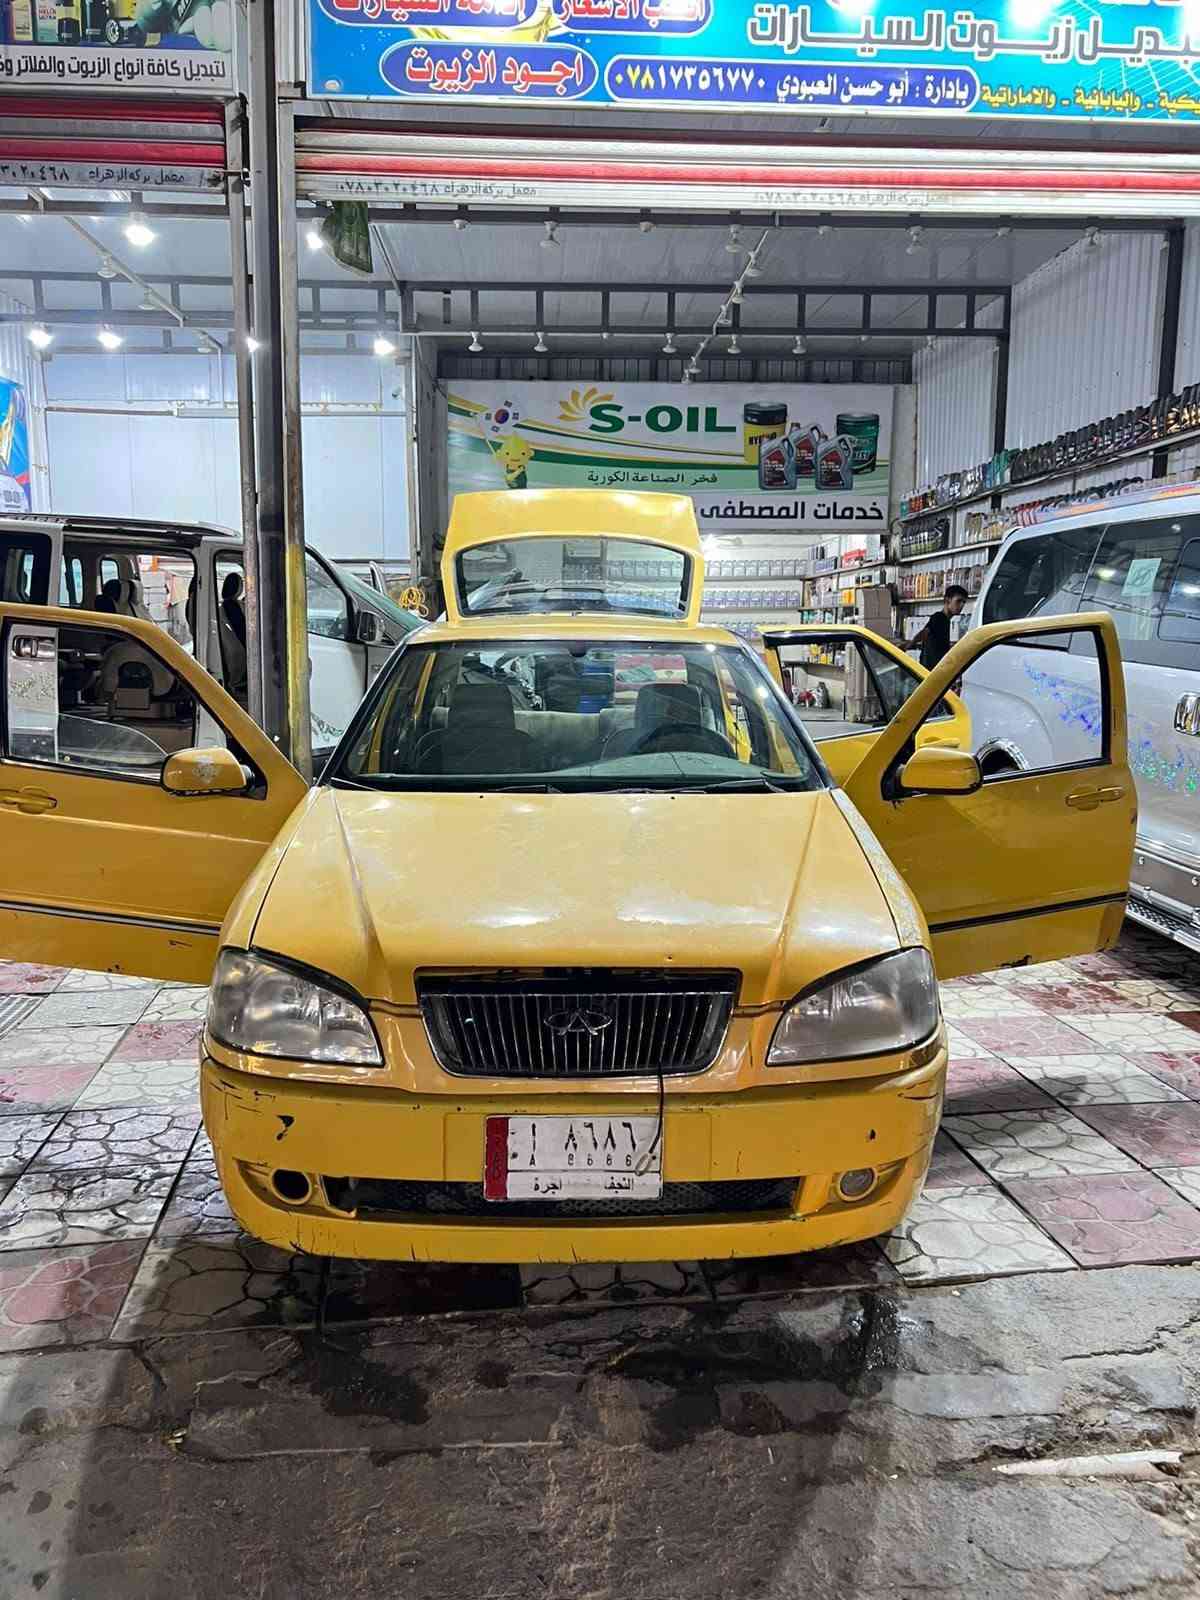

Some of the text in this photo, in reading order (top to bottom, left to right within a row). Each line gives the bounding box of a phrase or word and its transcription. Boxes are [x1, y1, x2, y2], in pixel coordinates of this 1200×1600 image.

[750, 6, 1200, 65] بديل زيوت السيارات
[16, 55, 65, 78] والفلاتر
[67, 57, 111, 78] الزيوت
[114, 58, 144, 81] انواع
[147, 58, 181, 77] كافة
[184, 60, 226, 82] لتبديل
[406, 47, 584, 95] اجود الزيوت
[616, 64, 766, 92] ٠٧٨١٧٣٥٦٧٧٠
[775, 72, 837, 102] العبودي
[839, 76, 883, 102] حسن
[588, 403, 737, 433] S-OIL
[587, 470, 718, 487] فخر الصناعة الكورية
[701, 500, 884, 520] خدمات المصطفى
[533, 1176, 635, 1194] النجف اجرة
